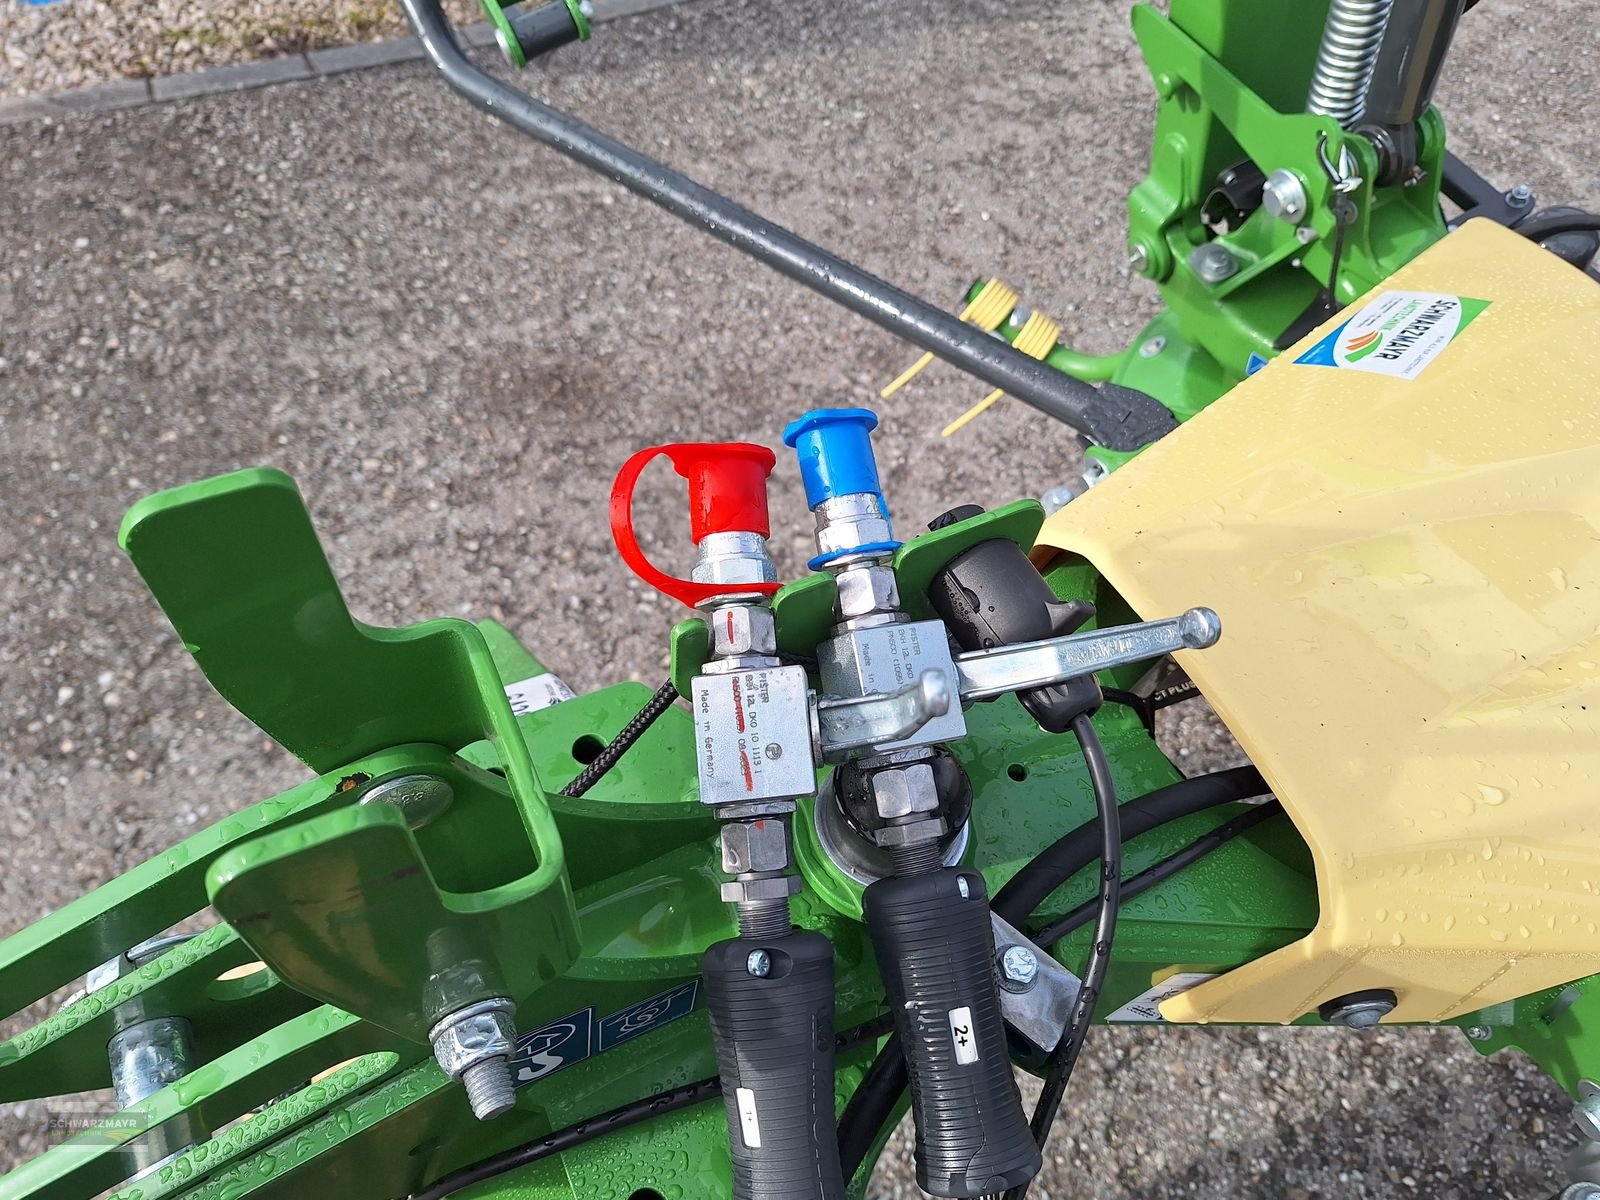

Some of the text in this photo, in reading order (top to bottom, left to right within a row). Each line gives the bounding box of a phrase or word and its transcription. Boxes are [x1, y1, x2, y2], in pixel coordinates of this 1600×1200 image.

[1374, 299, 1458, 361] SCHWARZMAYR
[861, 643, 875, 684] Made in
[1167, 680, 1197, 696] PLUS
[700, 689, 715, 780] Made in Germany
[953, 1025, 969, 1048] 2+
